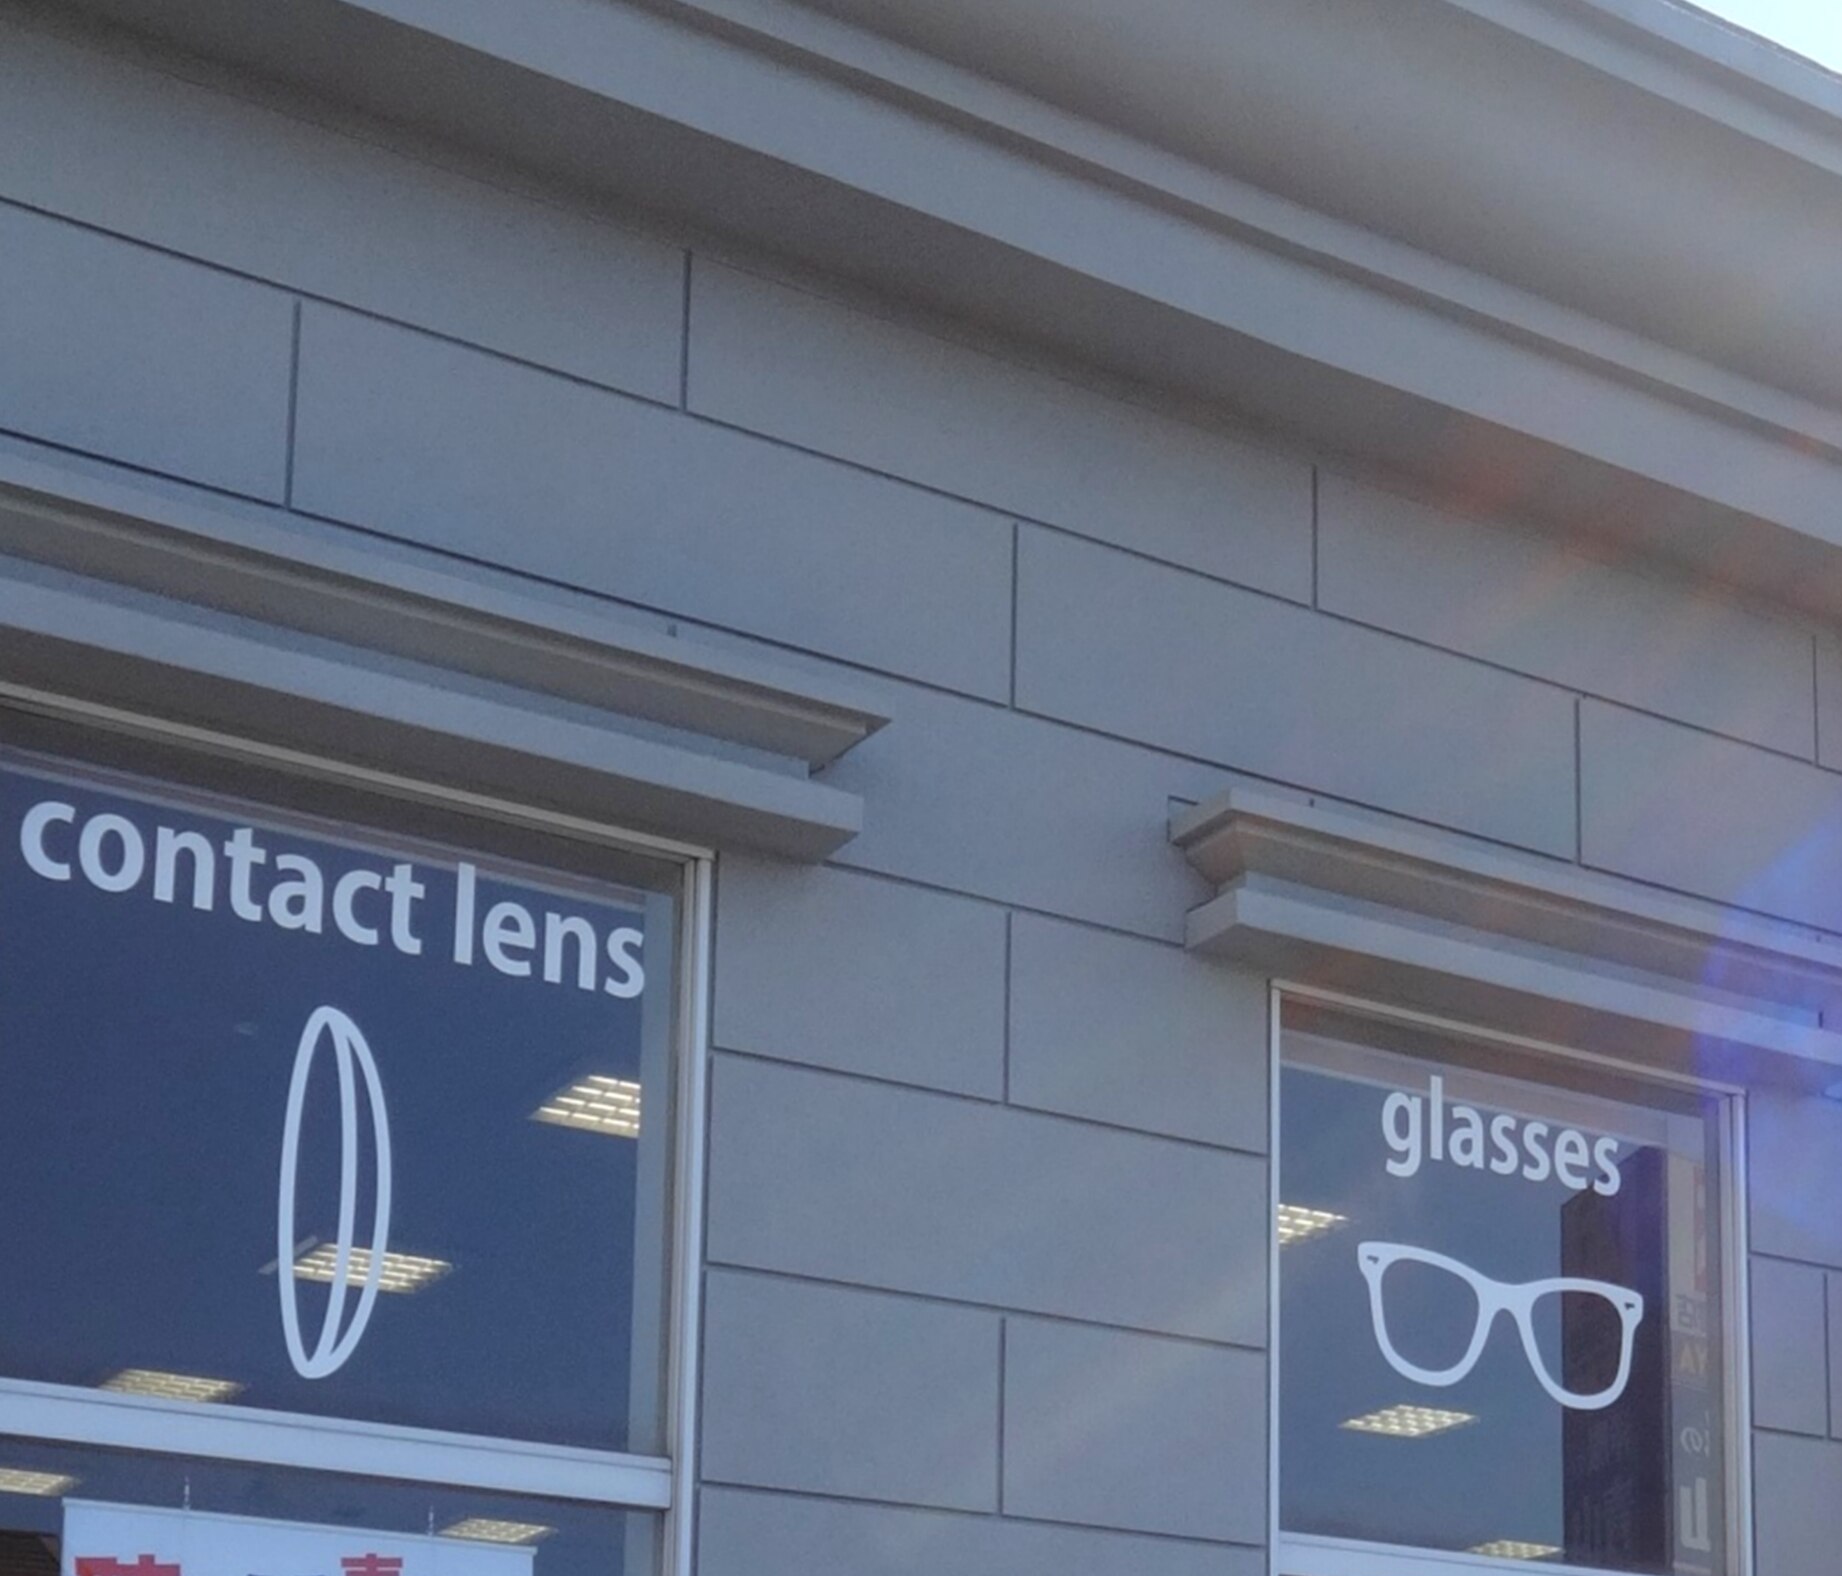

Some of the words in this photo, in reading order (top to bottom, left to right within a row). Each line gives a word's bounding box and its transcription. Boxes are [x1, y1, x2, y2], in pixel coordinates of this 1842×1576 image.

[20, 801, 426, 956] contact
[454, 863, 645, 999] lens
[1382, 1075, 1622, 1196] glasses
